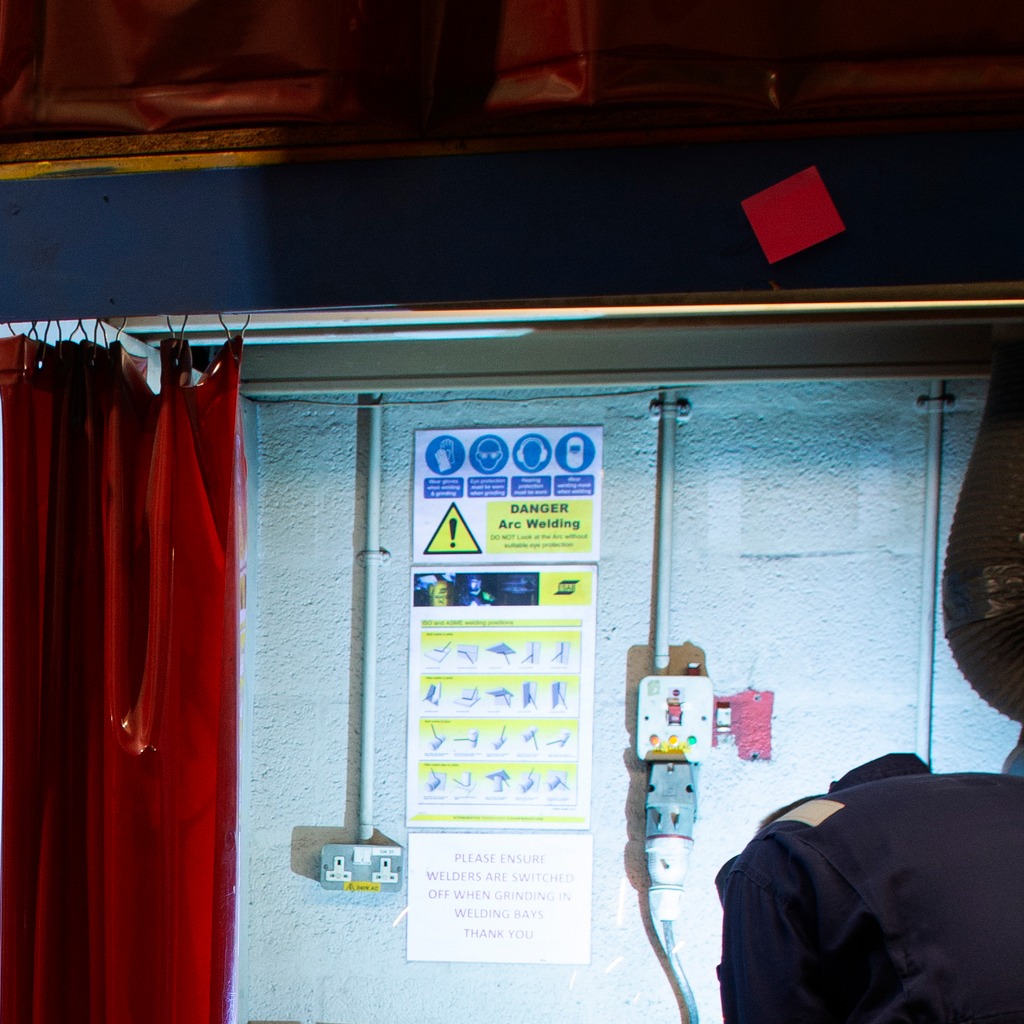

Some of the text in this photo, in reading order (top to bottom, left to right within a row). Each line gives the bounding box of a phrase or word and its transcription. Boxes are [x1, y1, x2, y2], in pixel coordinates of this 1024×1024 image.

[510, 503, 569, 514] DANGER
[498, 518, 581, 531] Arc Welding
[454, 853, 546, 864] PLEASE ENSURE
[426, 871, 574, 883] WELDERS ARE SWITCHED
[428, 889, 571, 901] OFF WHEN GRINDING IN
[454, 908, 544, 920] WELDING BAYS
[464, 928, 534, 939] THANK YOU
